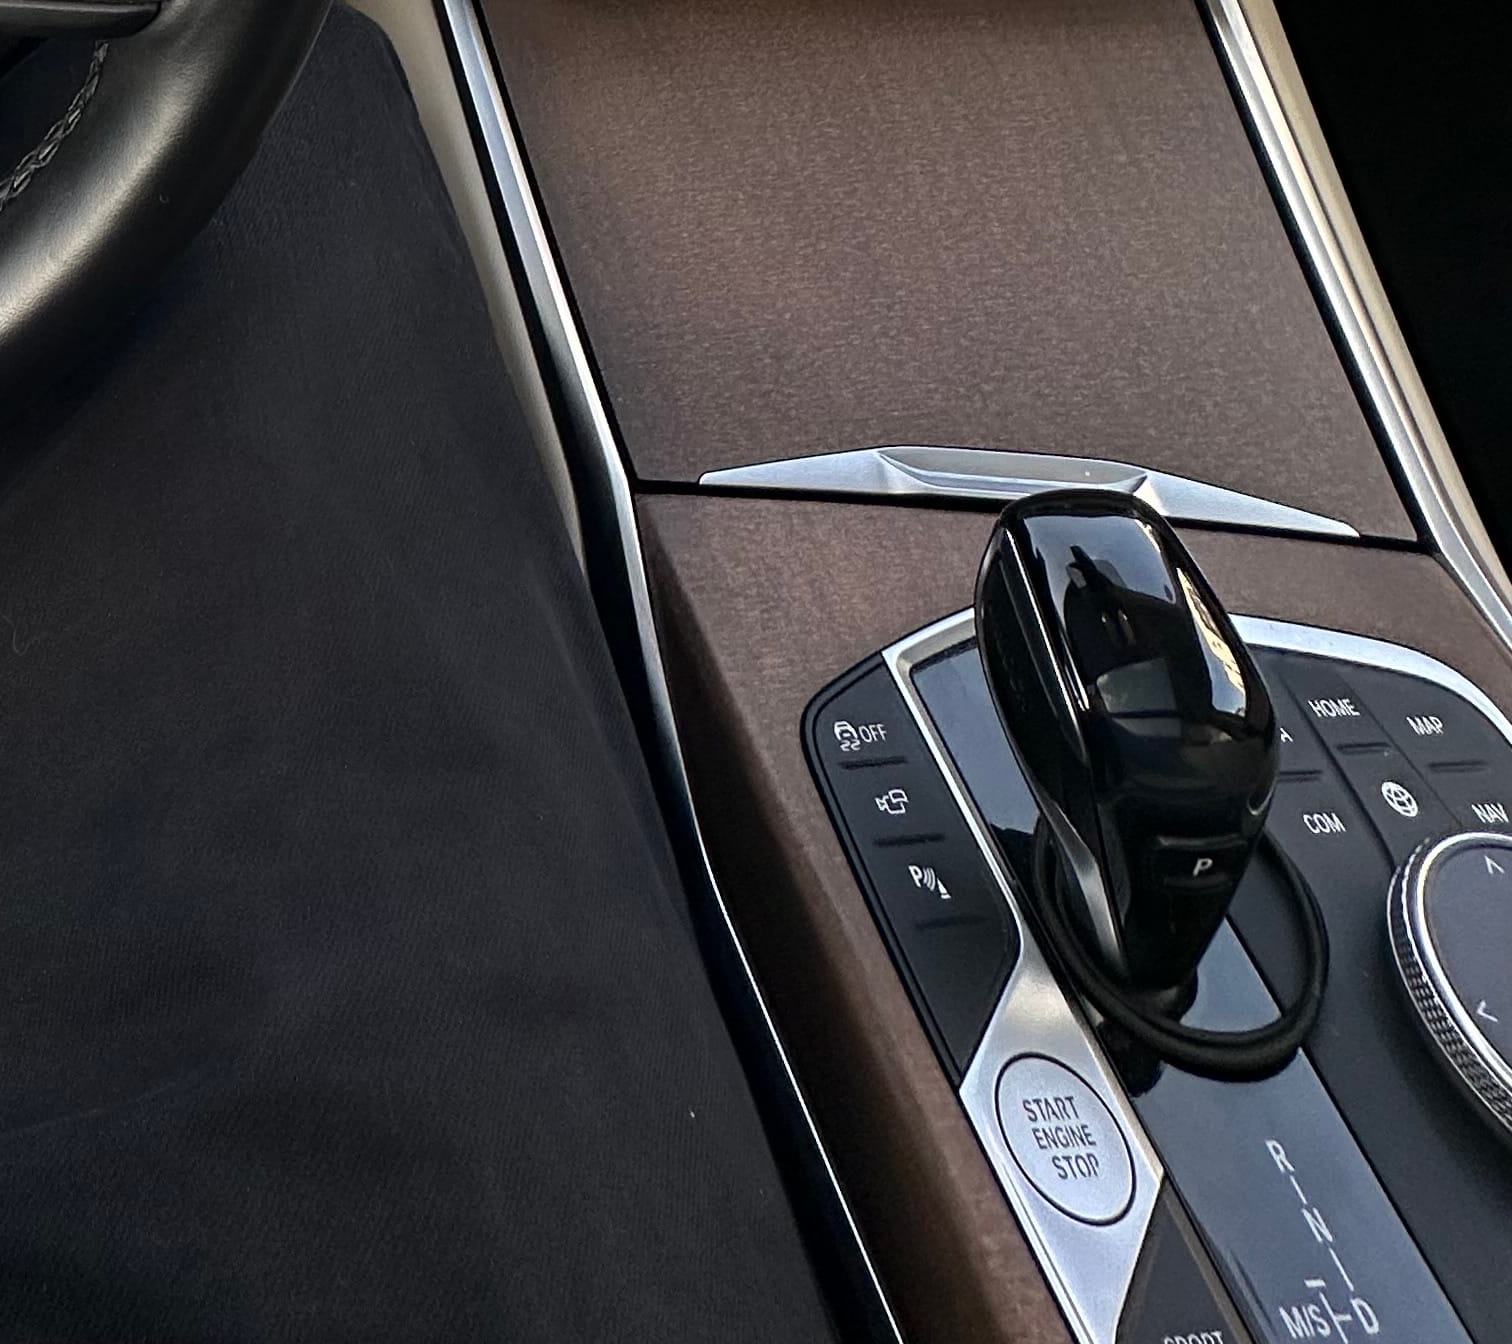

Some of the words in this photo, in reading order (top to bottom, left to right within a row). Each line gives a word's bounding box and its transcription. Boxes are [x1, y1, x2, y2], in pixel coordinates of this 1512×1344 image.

[1308, 698, 1361, 718] HOME
[858, 723, 887, 743] OFF
[1406, 715, 1444, 736] MAP
[1303, 812, 1346, 834] COM
[1471, 803, 1510, 824] NAV
[1193, 858, 1213, 877] P
[1022, 1095, 1080, 1123] START
[1031, 1124, 1097, 1150] ENGINE
[1051, 1152, 1100, 1180] STOP
[1265, 1139, 1295, 1174] R
[1301, 1207, 1334, 1244] N
[1279, 1303, 1332, 1340] M/S
[1350, 1296, 1380, 1335] D
